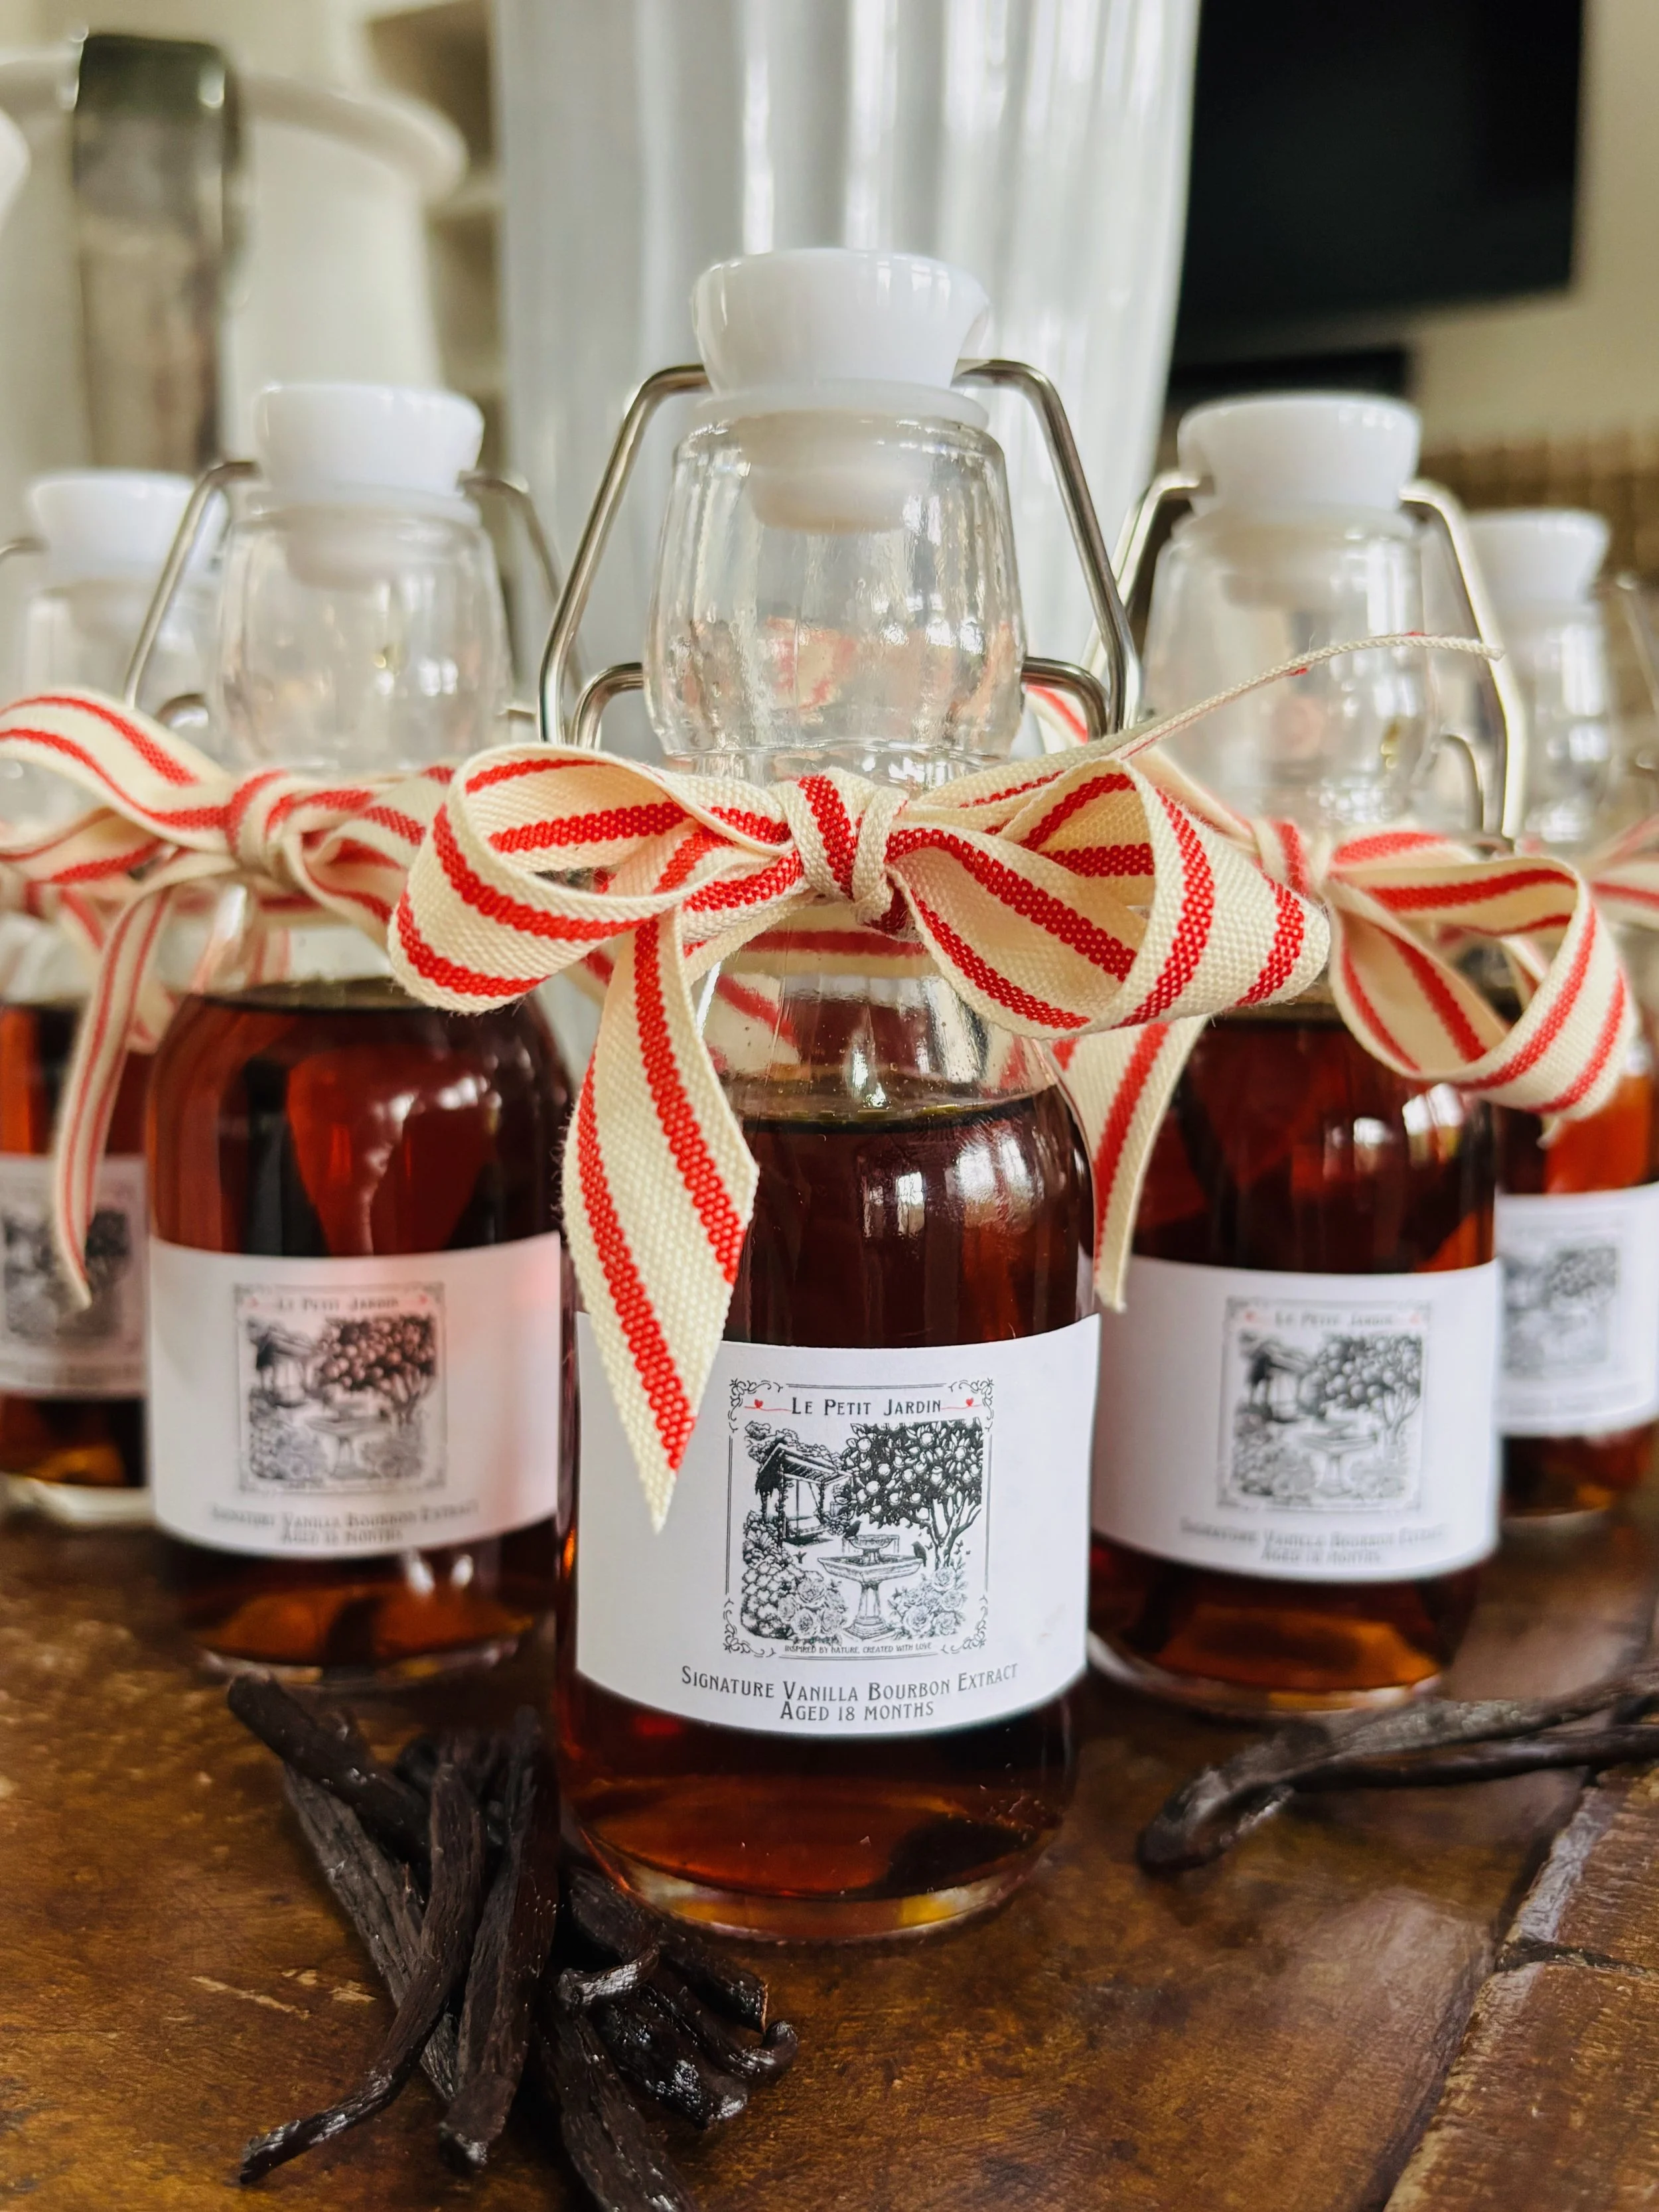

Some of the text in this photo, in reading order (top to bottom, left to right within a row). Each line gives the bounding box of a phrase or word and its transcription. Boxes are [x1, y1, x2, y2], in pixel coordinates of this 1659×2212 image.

[791, 1396, 941, 1416] LE PETIT JARDIN
[682, 1662, 1019, 1702] SIGNATURE VANILLA BOURBON EXTRACT
[780, 1700, 830, 1722] AGED
[837, 1706, 855, 1722] 18
